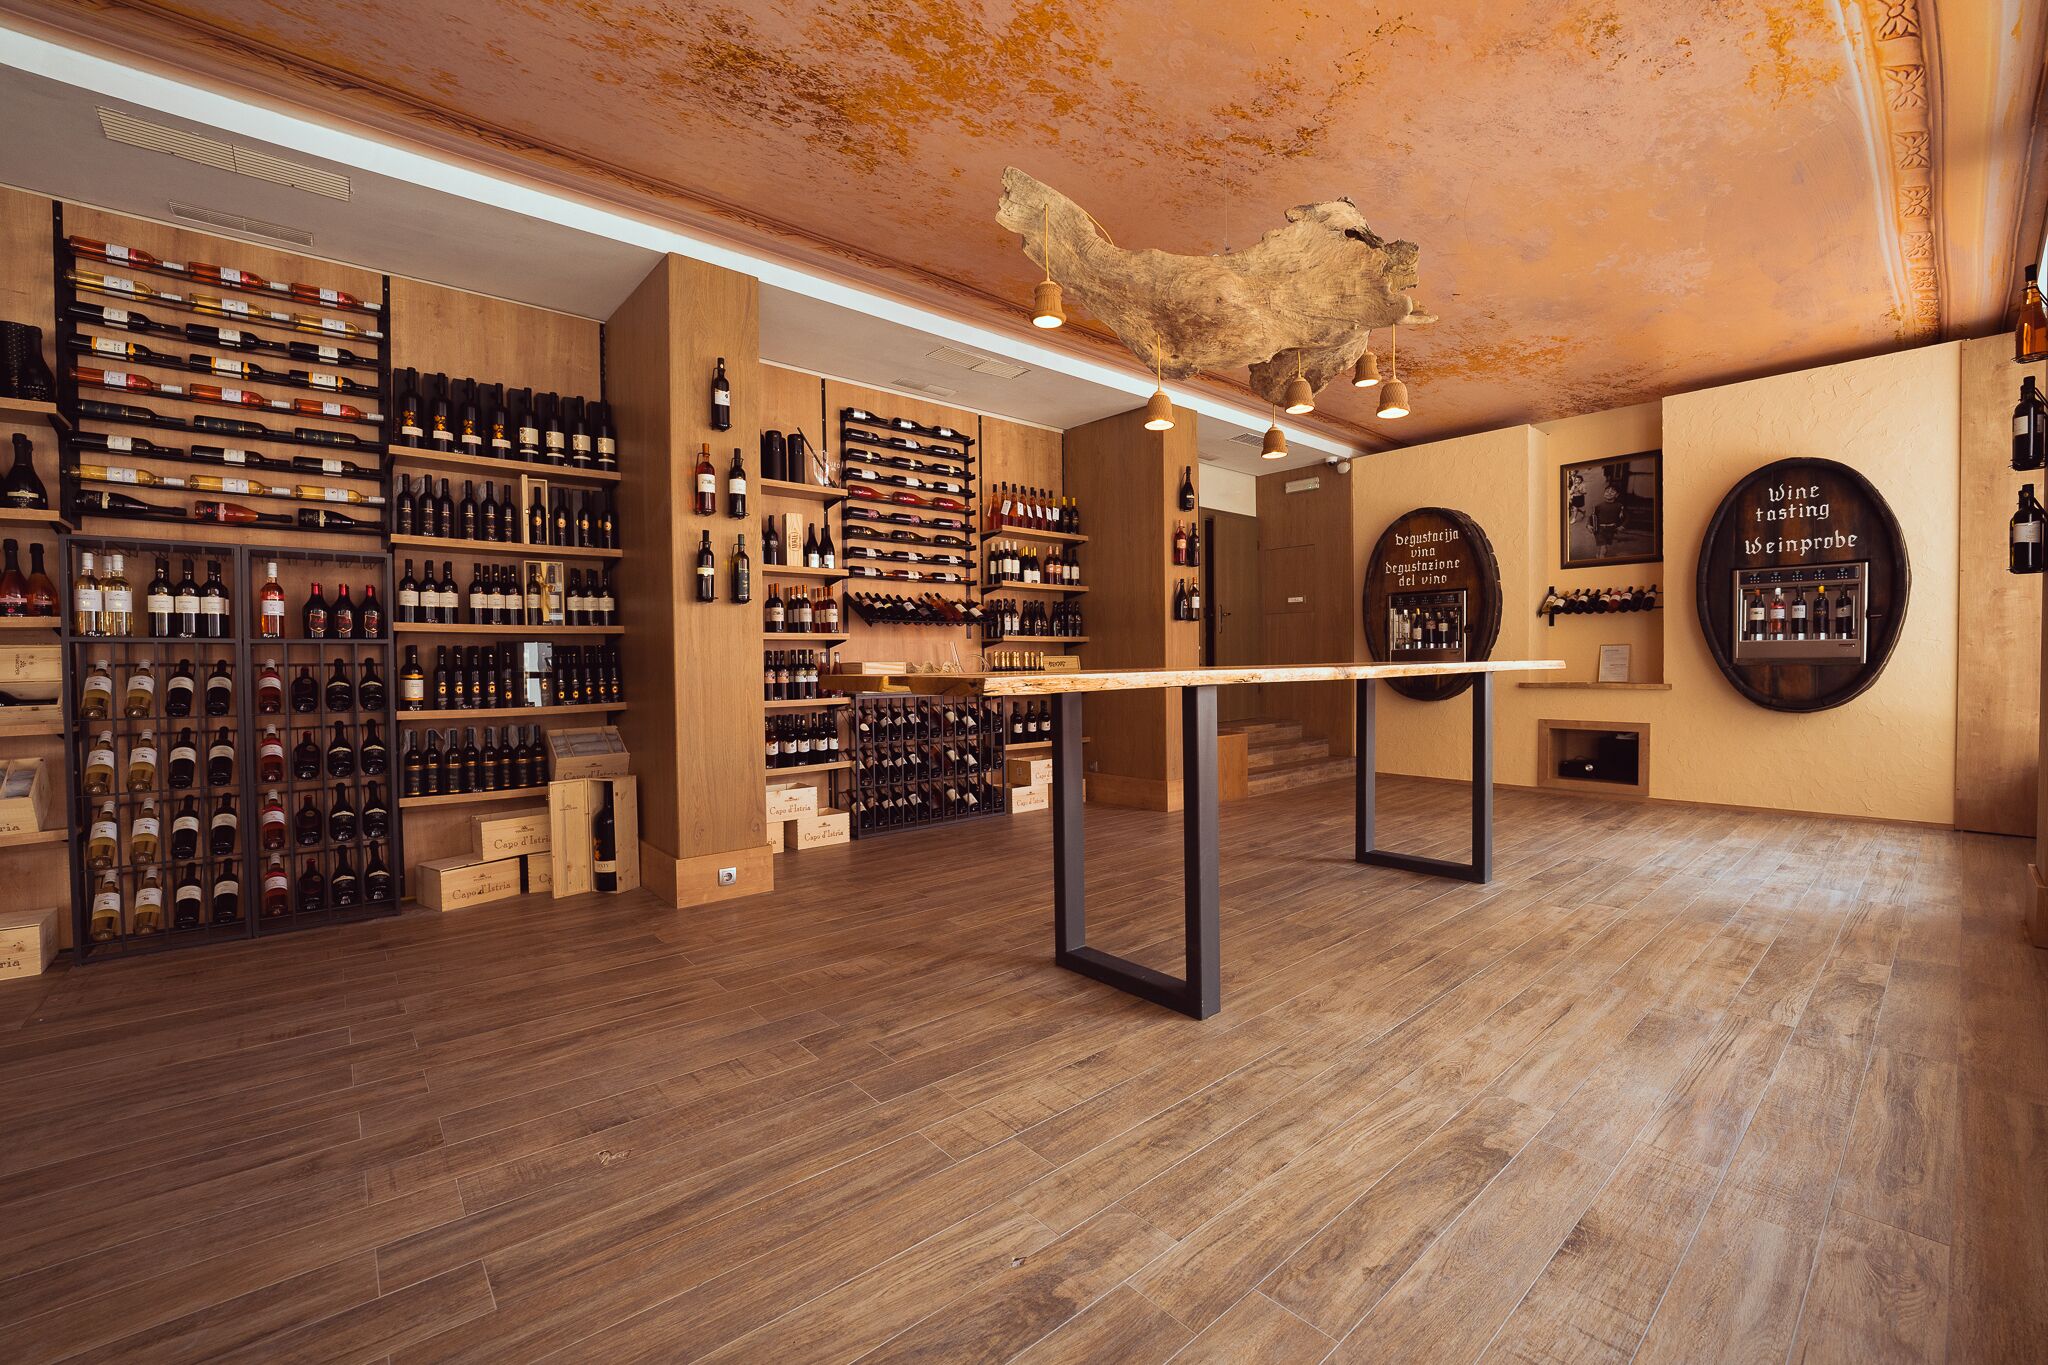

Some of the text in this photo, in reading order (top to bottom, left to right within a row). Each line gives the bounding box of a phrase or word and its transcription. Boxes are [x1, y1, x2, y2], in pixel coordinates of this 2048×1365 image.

[1768, 483, 1820, 502] Wine
[1755, 503, 1830, 522] tasting
[1745, 529, 1858, 556] Weinprobe
[1410, 546, 1436, 558] vina
[1398, 573, 1448, 587] del vino
[769, 806, 787, 815] Capo
[804, 832, 821, 842] Capo
[494, 839, 519, 850] Capo
[452, 889, 477, 900] Capo
